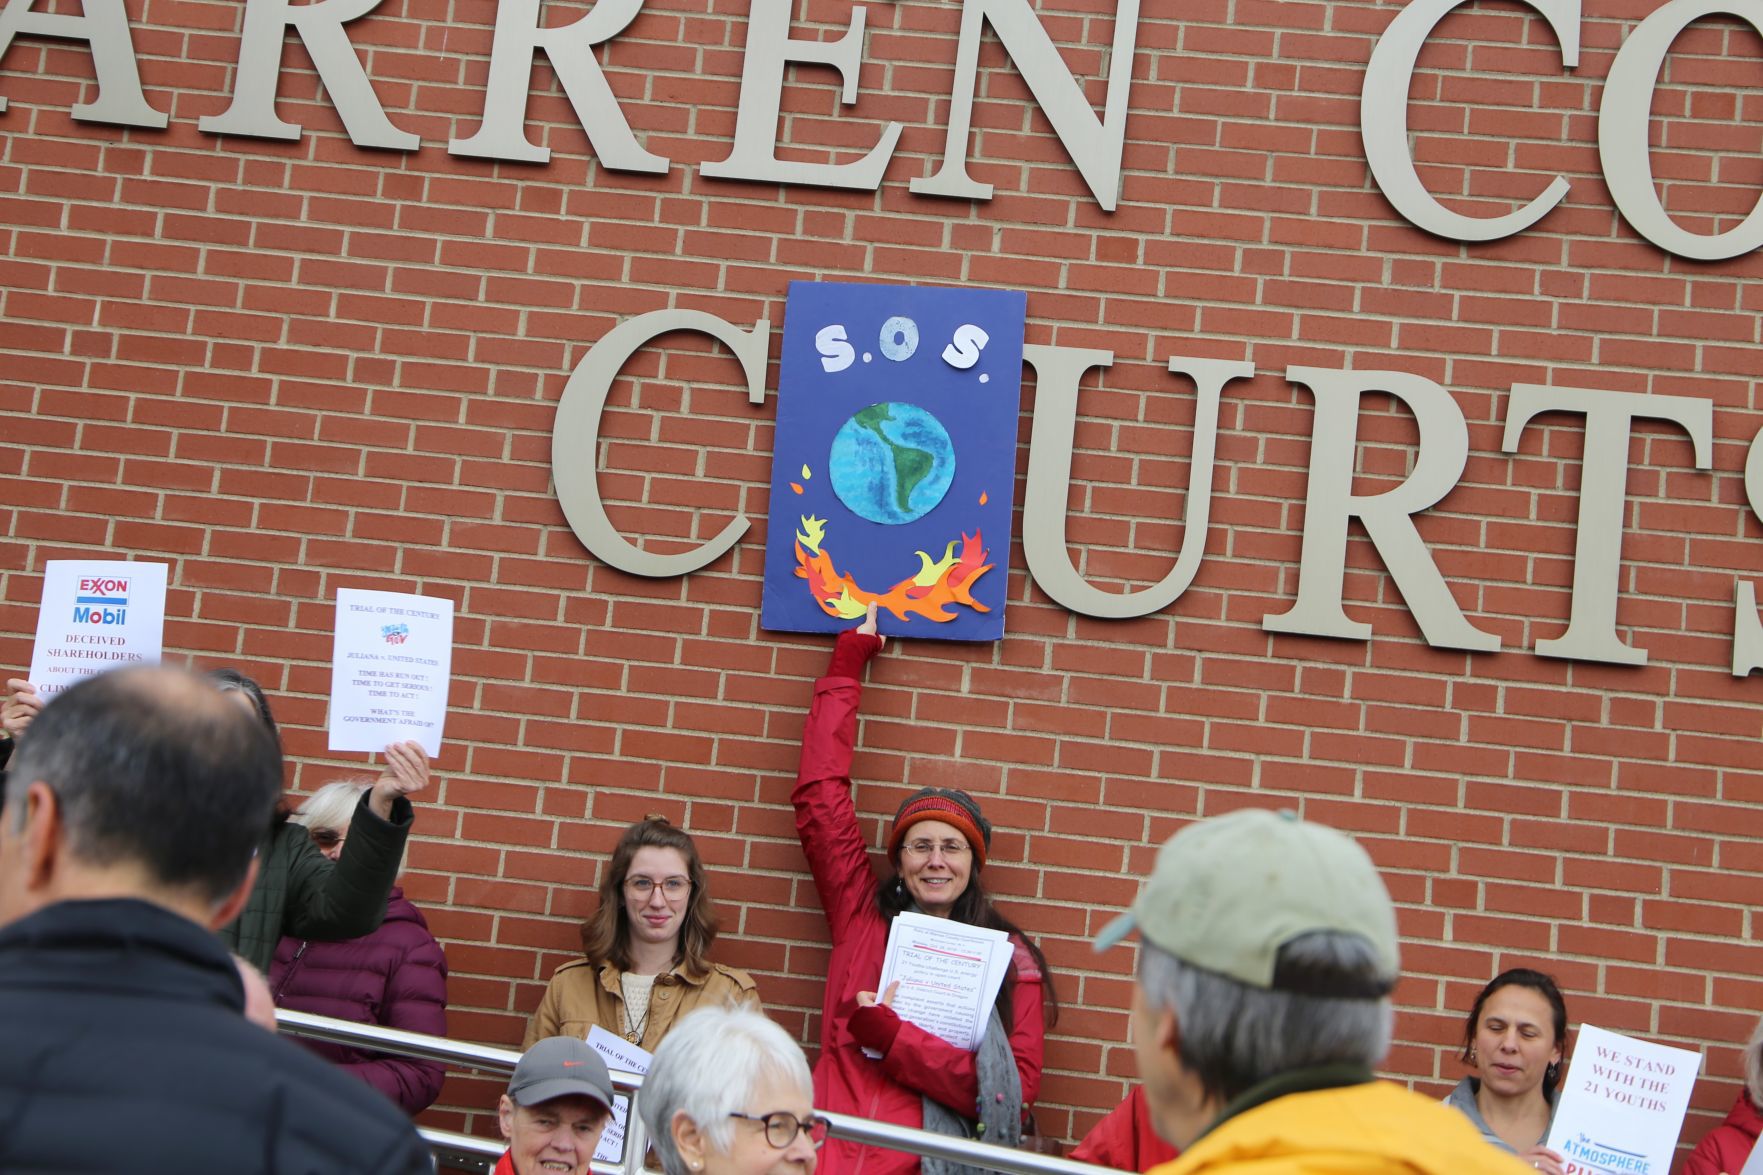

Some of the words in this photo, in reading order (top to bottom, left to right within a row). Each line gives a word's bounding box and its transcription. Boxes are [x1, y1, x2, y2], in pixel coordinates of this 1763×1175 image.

[79, 577, 128, 596] EXXON
[73, 606, 126, 625] Mobil
[350, 604, 374, 613] TRIAL
[406, 609, 440, 620] CENTURY
[65, 634, 126, 646] DECEIVED
[46, 648, 143, 661] SHAREHOLDERS
[347, 652, 379, 660] JULIANA
[388, 654, 414, 663] UNITED
[416, 657, 439, 666] STATES
[47, 666, 74, 674] ABOUT
[343, 716, 396, 724] GOVERNMENT
[903, 950, 921, 959] TRIAL
[951, 960, 981, 968] CENTURY
[931, 980, 951, 988] United
[596, 1042, 614, 1056] TRIAL
[625, 1057, 637, 1068] THE
[638, 1064, 648, 1072] CE
[1597, 1046, 1620, 1062] WE
[1625, 1055, 1676, 1076] STAND
[1592, 1064, 1634, 1086] WITH
[1639, 1078, 1670, 1094] THE
[1584, 1080, 1598, 1094] 21
[1606, 1087, 1666, 1112] YOUTHS
[1564, 1139, 1650, 1175] ATMOSPHERE
